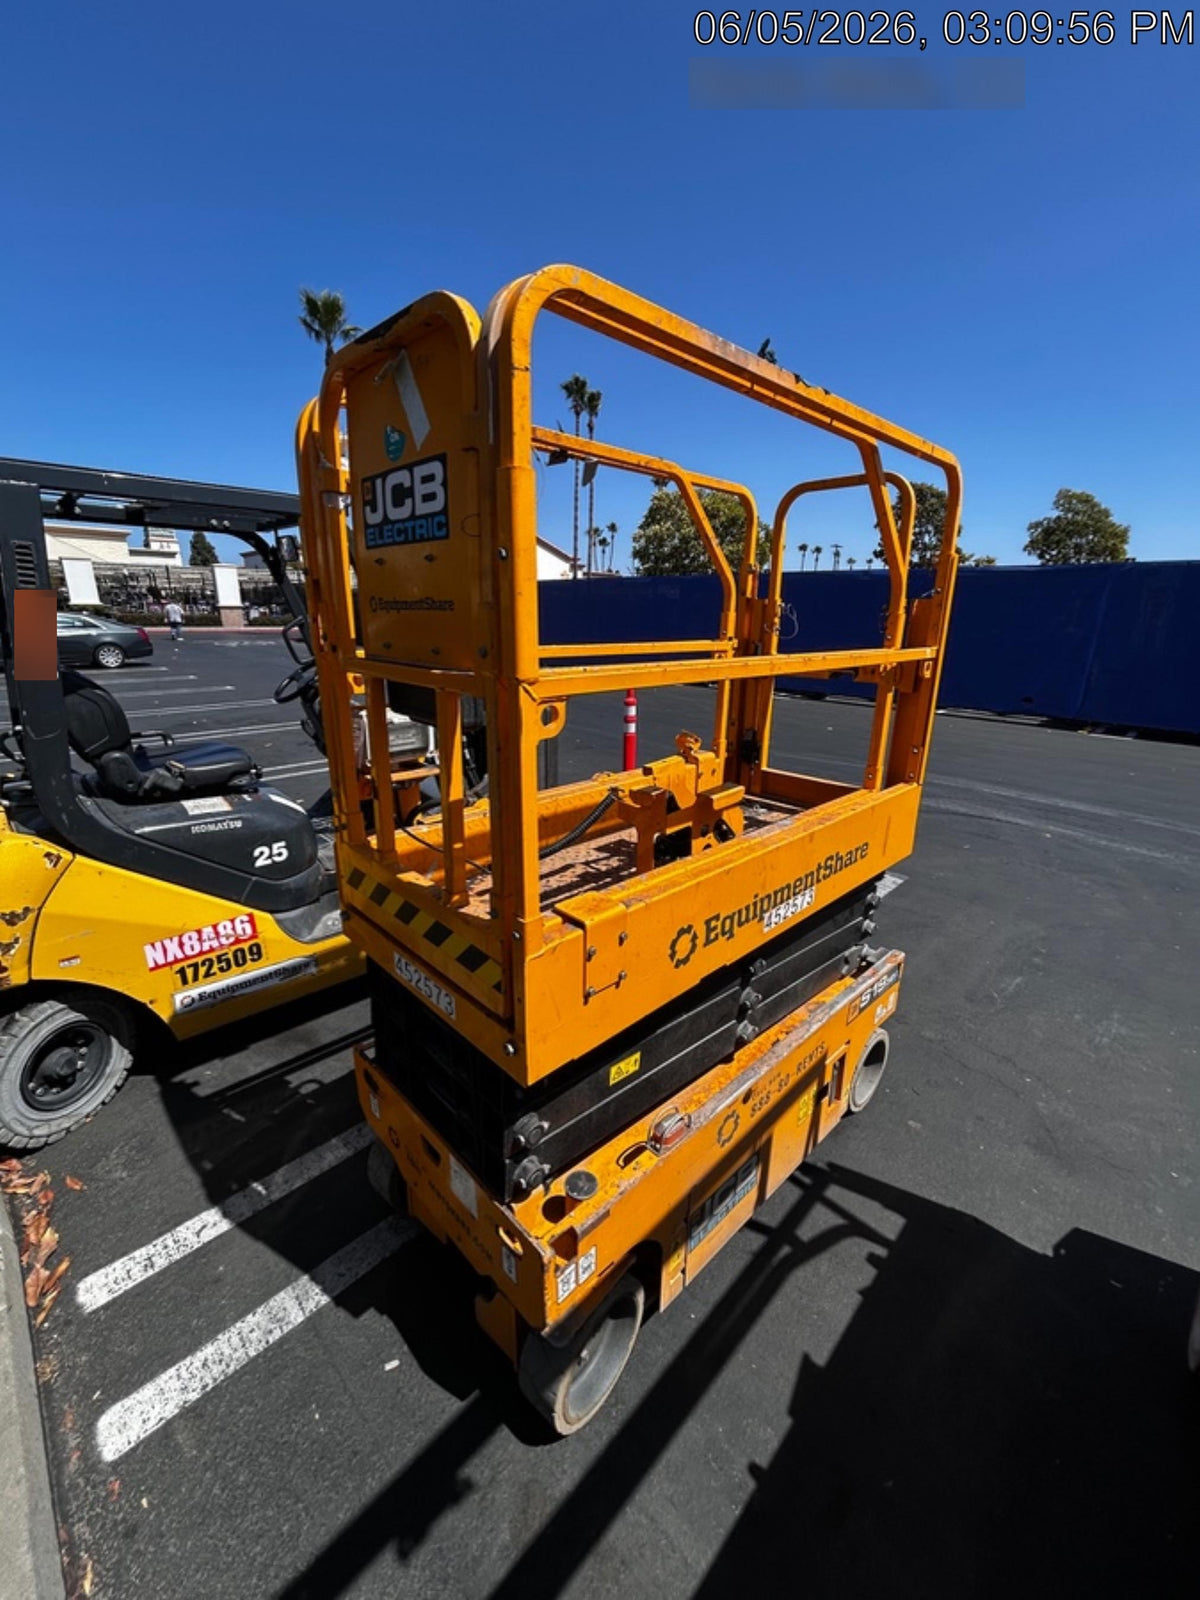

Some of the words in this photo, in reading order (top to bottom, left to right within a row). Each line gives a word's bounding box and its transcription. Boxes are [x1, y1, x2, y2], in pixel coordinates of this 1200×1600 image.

[364, 461, 446, 525] JCB
[365, 514, 448, 548] ELECTRIC
[378, 596, 456, 614] EquipmentShare
[191, 819, 243, 834] KOMATSU
[252, 840, 289, 868] 25
[703, 841, 870, 948] EquipmentShare
[765, 888, 816, 930] 452573
[143, 914, 254, 967] NX8A86
[174, 941, 264, 986] 172509
[197, 959, 313, 1002] EquipmentShare
[395, 953, 457, 1018] 452573
